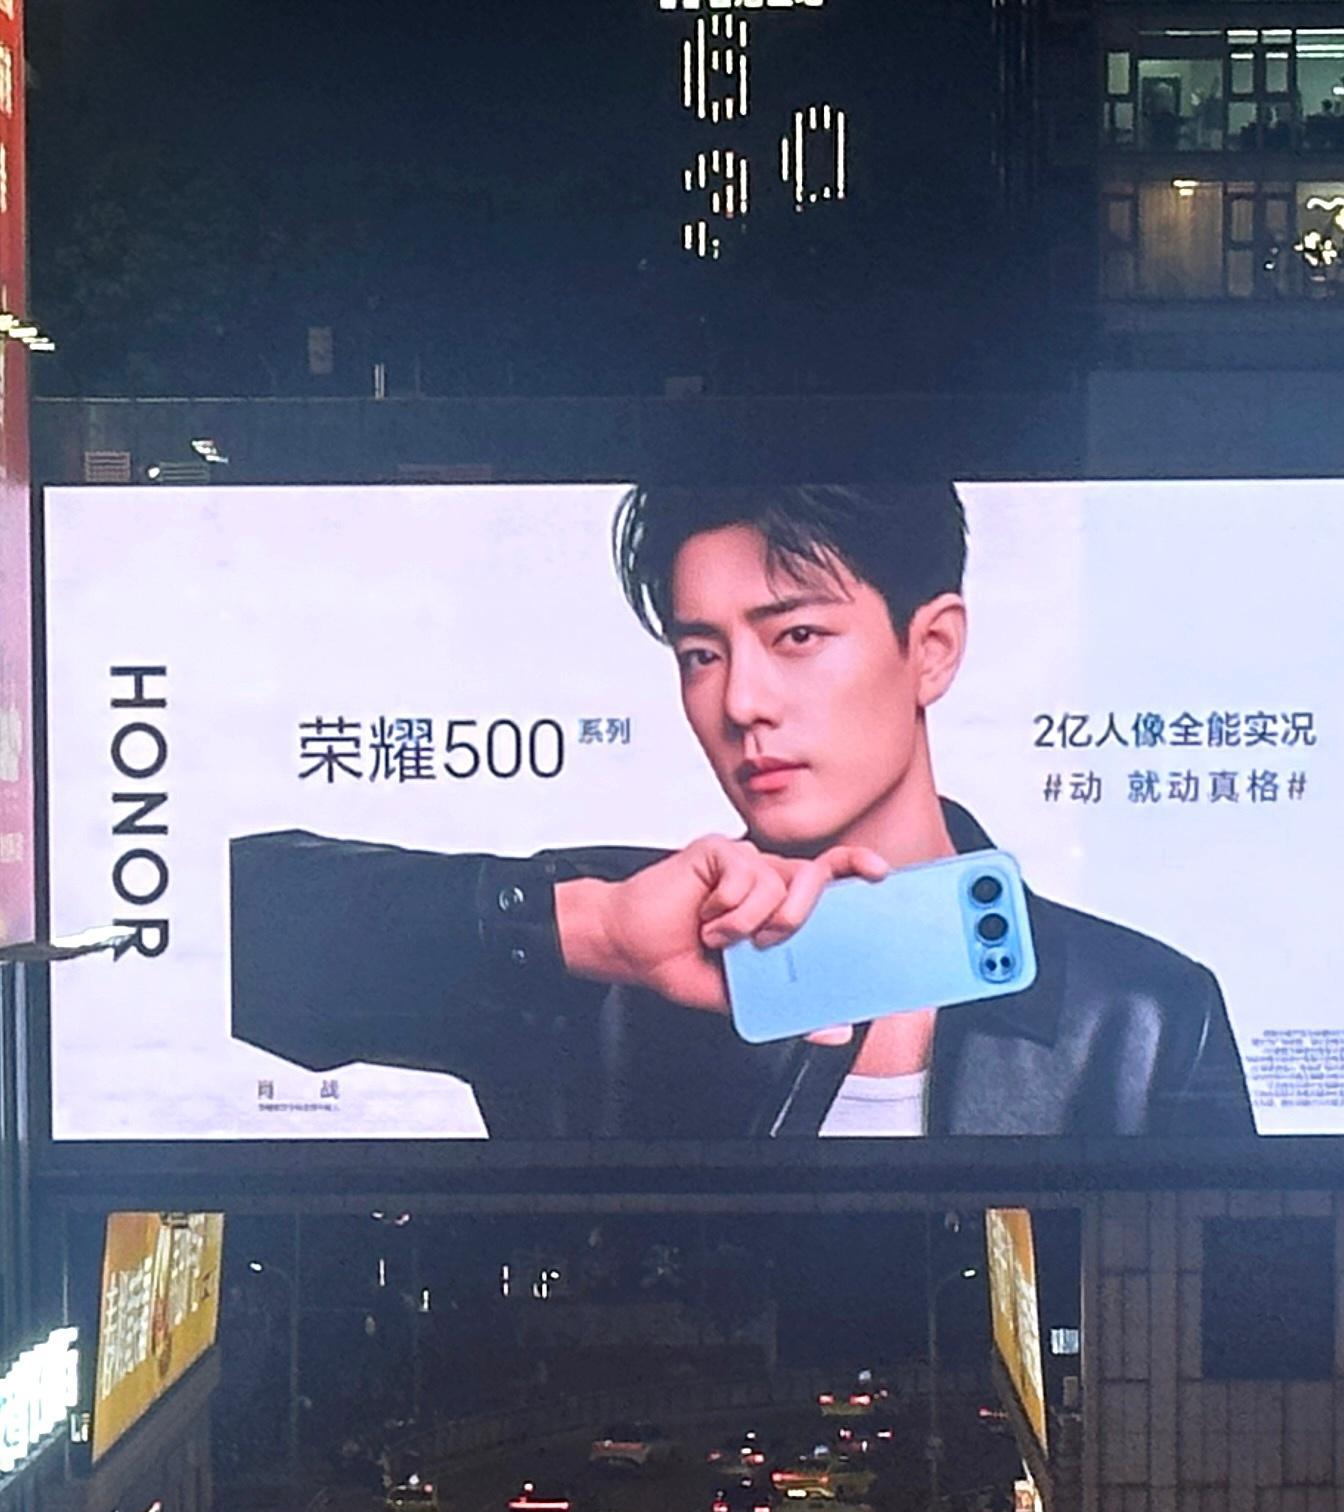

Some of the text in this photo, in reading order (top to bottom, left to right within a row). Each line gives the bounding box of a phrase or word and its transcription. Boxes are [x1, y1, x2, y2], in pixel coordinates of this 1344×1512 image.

[297, 716, 632, 785] 荣耀500 系列
[1032, 711, 1318, 749] 2亿人像全能实况
[109, 664, 170, 963] HONOR
[1043, 769, 1307, 805] #动 就动真格#
